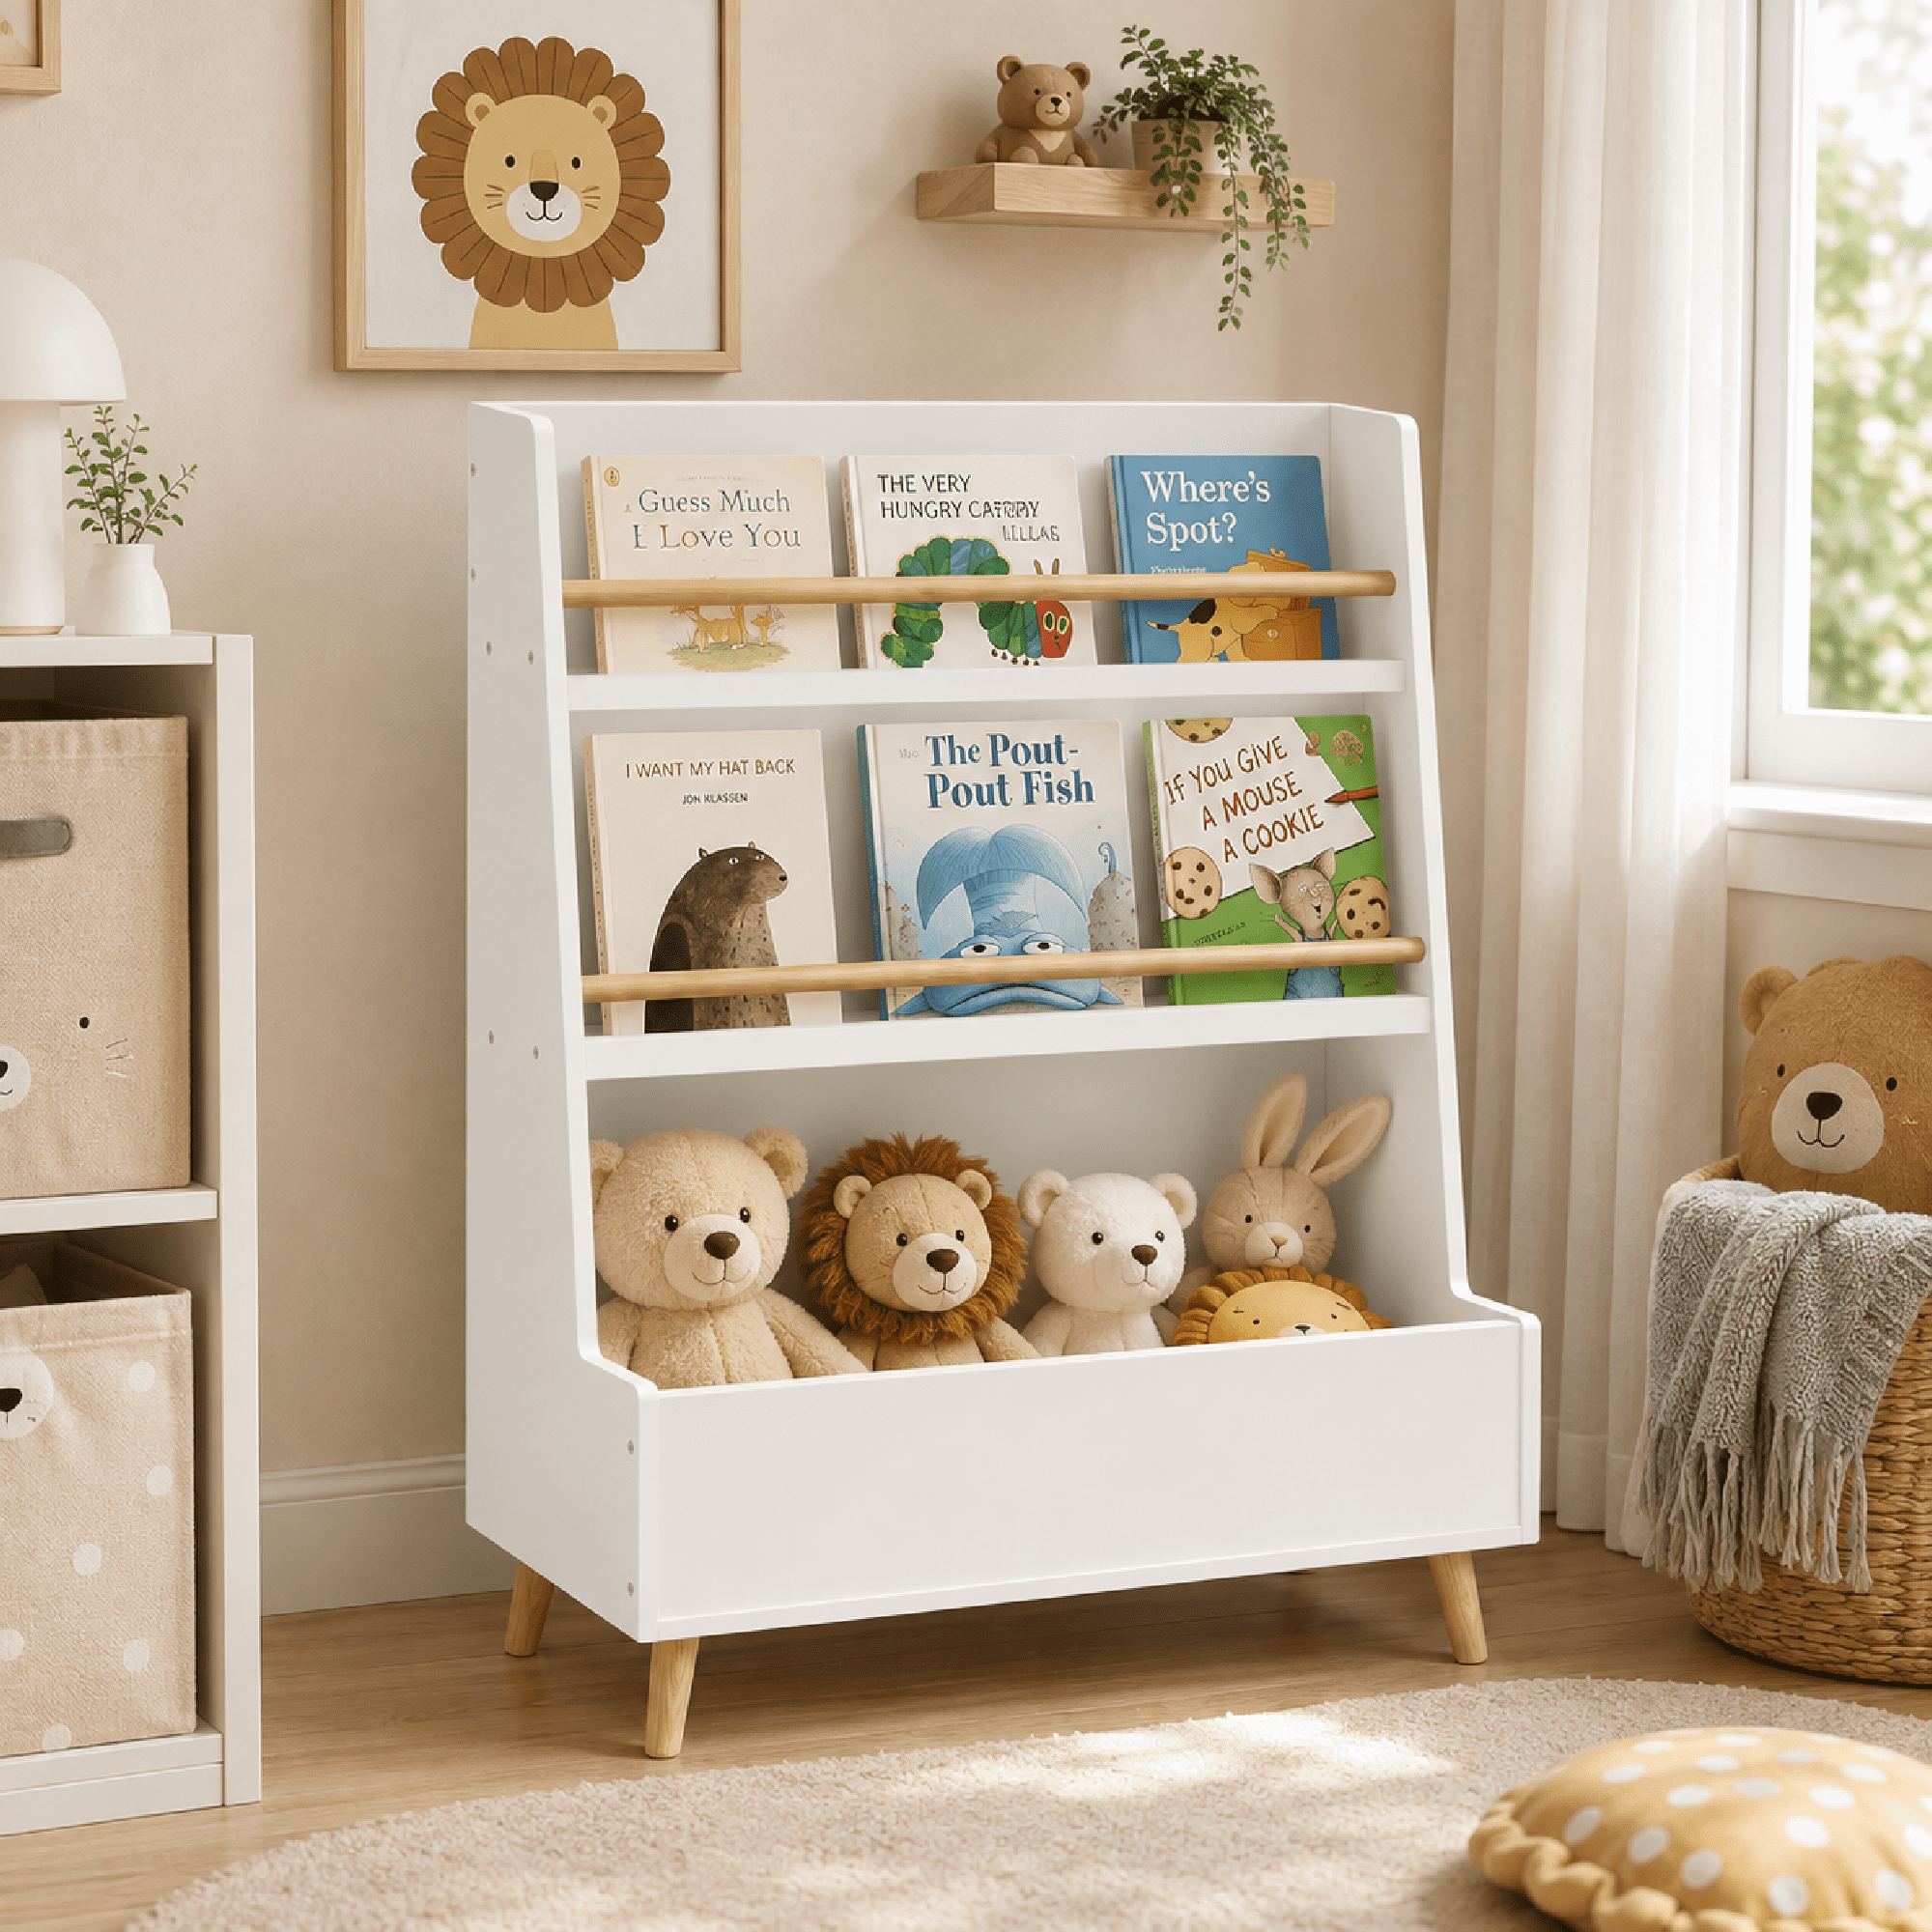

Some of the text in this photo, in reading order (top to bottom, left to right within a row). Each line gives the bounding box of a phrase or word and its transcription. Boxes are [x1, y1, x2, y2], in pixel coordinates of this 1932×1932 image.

[877, 473, 972, 493] THE VERY
[1140, 470, 1271, 502] Where's
[639, 488, 790, 514] Guess Much
[880, 500, 963, 519] HUNGRY
[660, 524, 732, 548] Love
[743, 522, 801, 548] You
[1147, 512, 1237, 552] Spot?
[924, 732, 1079, 767] The Pout-
[625, 757, 795, 779] I WANT MY HAT BACK
[1165, 735, 1288, 805] IF YOU GIVE
[924, 768, 1095, 810] Pout Fish
[1203, 770, 1302, 831] A MOUSE
[1224, 803, 1323, 863] A COOKIE
